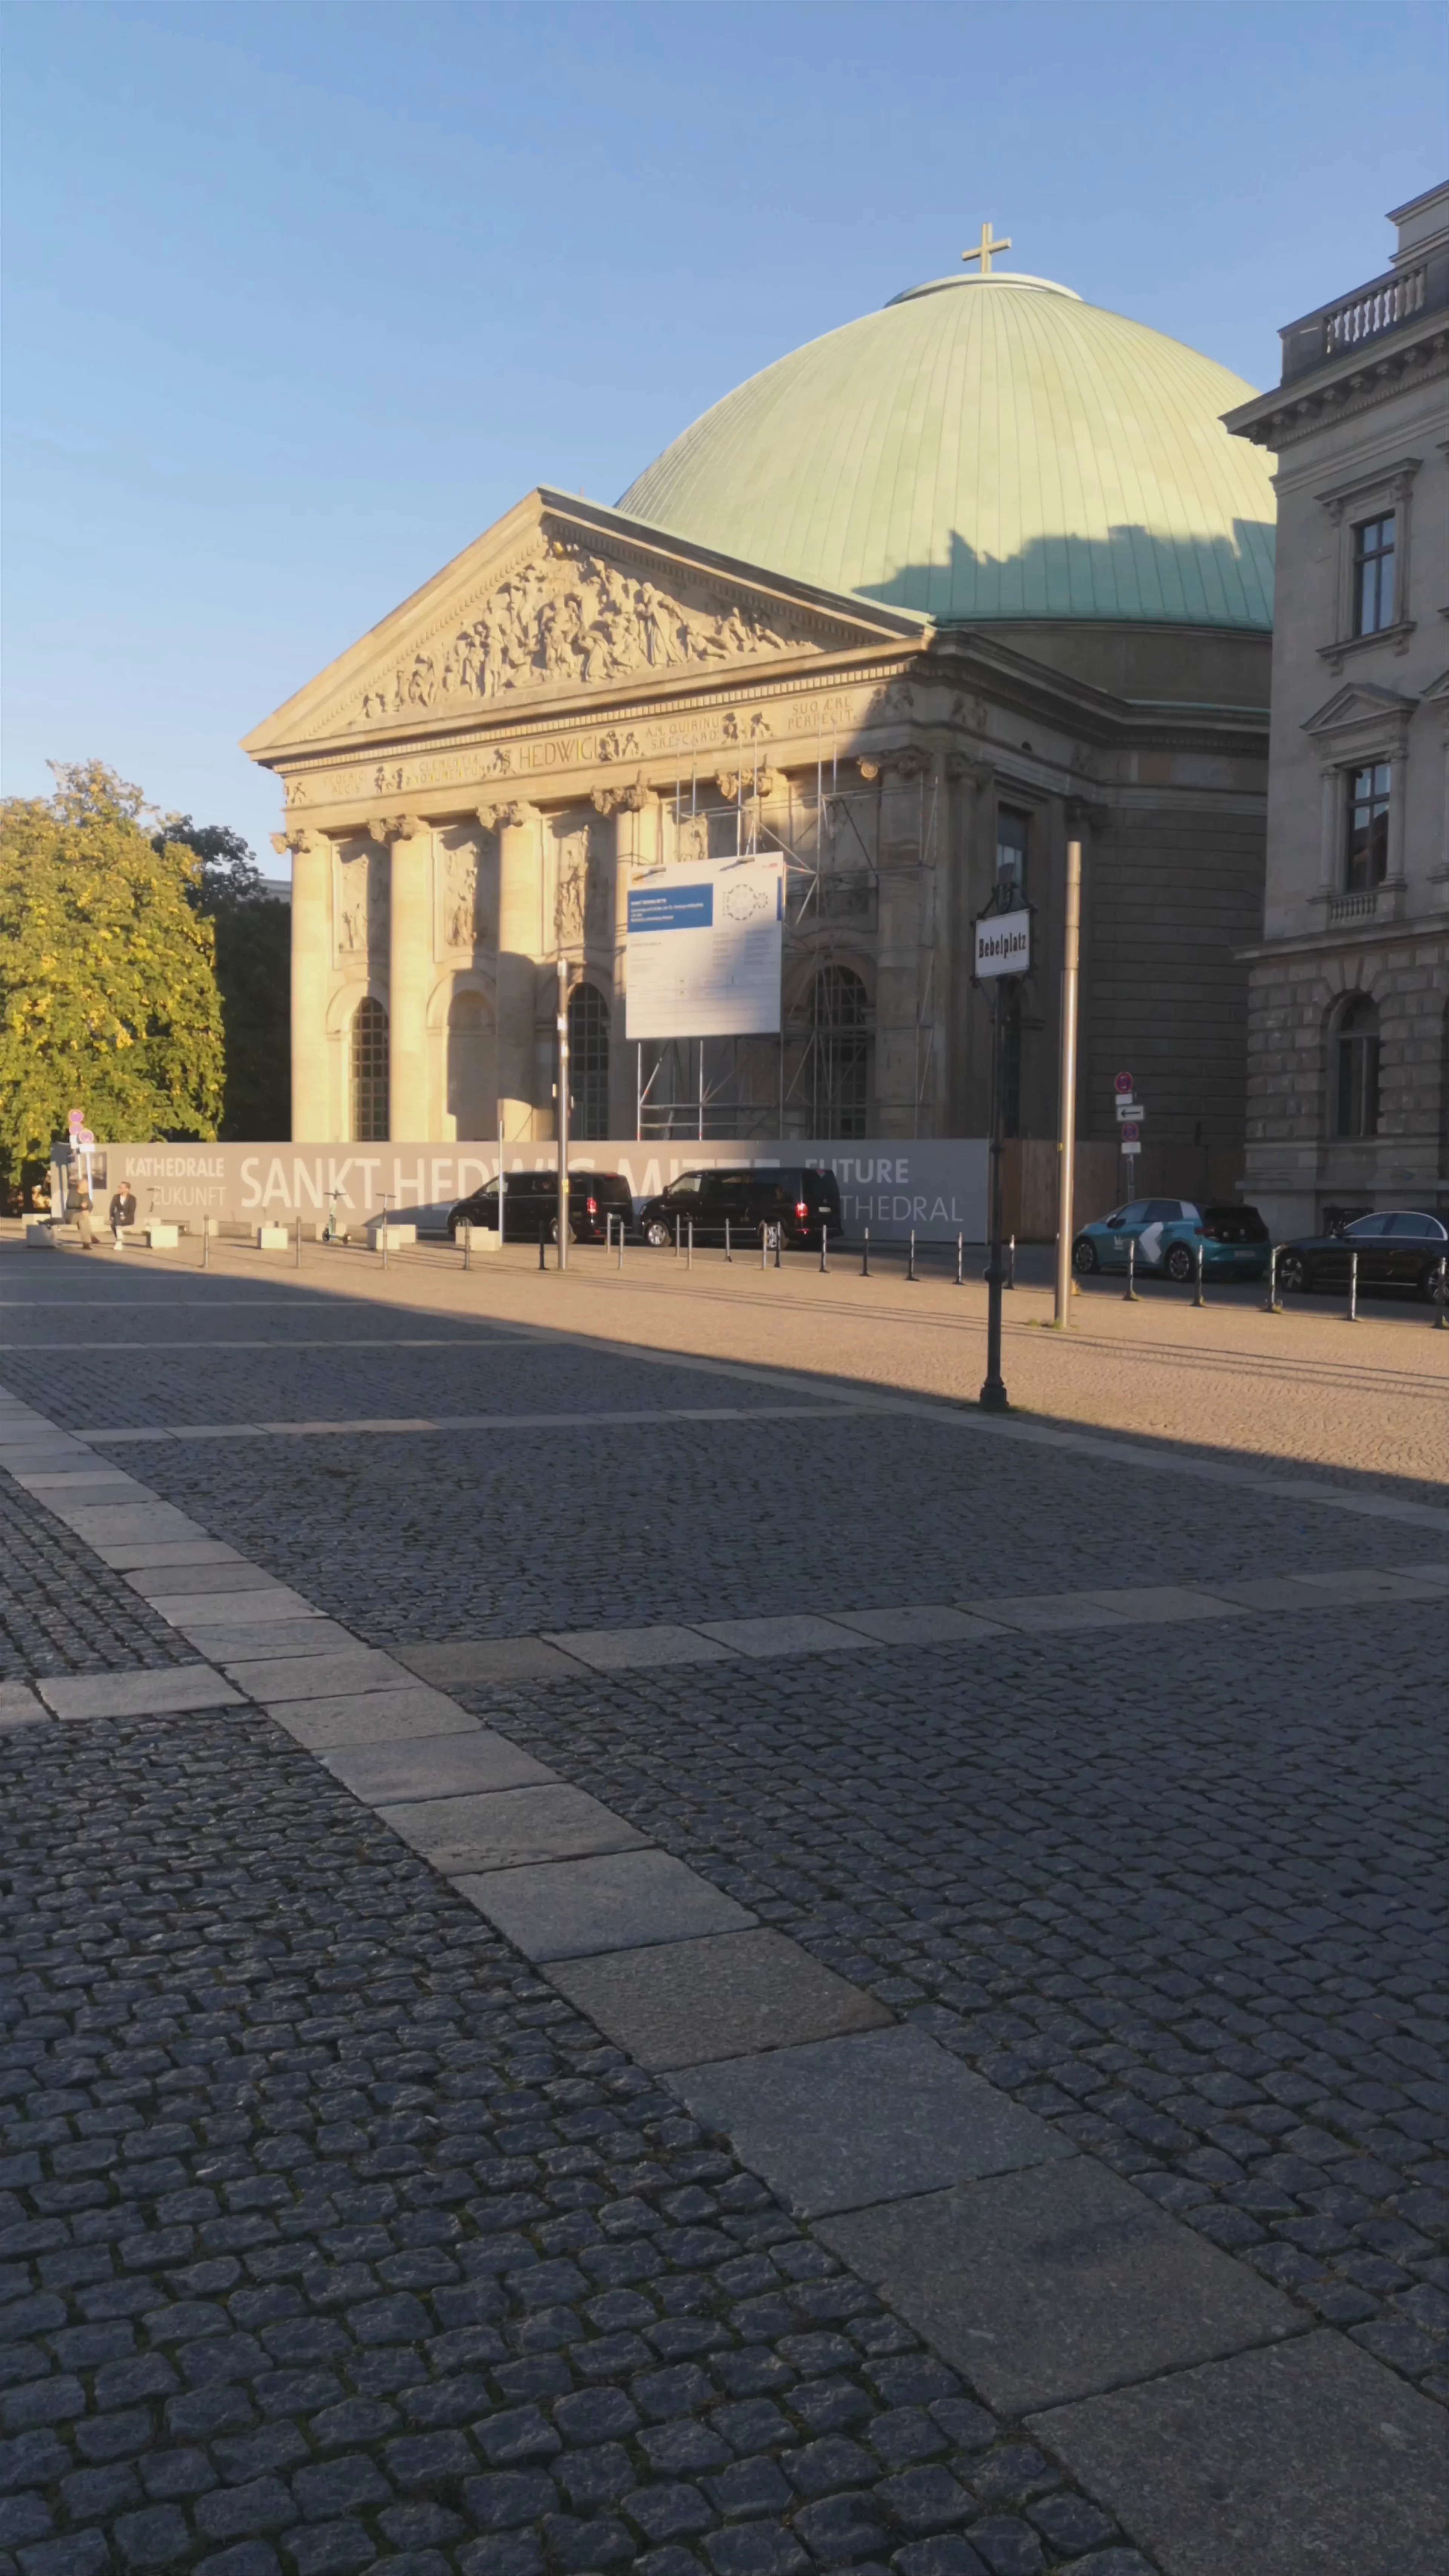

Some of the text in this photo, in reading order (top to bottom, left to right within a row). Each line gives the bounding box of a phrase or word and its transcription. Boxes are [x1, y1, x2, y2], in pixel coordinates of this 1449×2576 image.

[978, 932, 1026, 959] Bebelplatz
[125, 1158, 224, 1177] KATHEDRALE
[152, 1186, 226, 1206] ZUKUNFT
[241, 1157, 381, 1209] SANKT
[840, 1195, 964, 1222] THEDRAL
